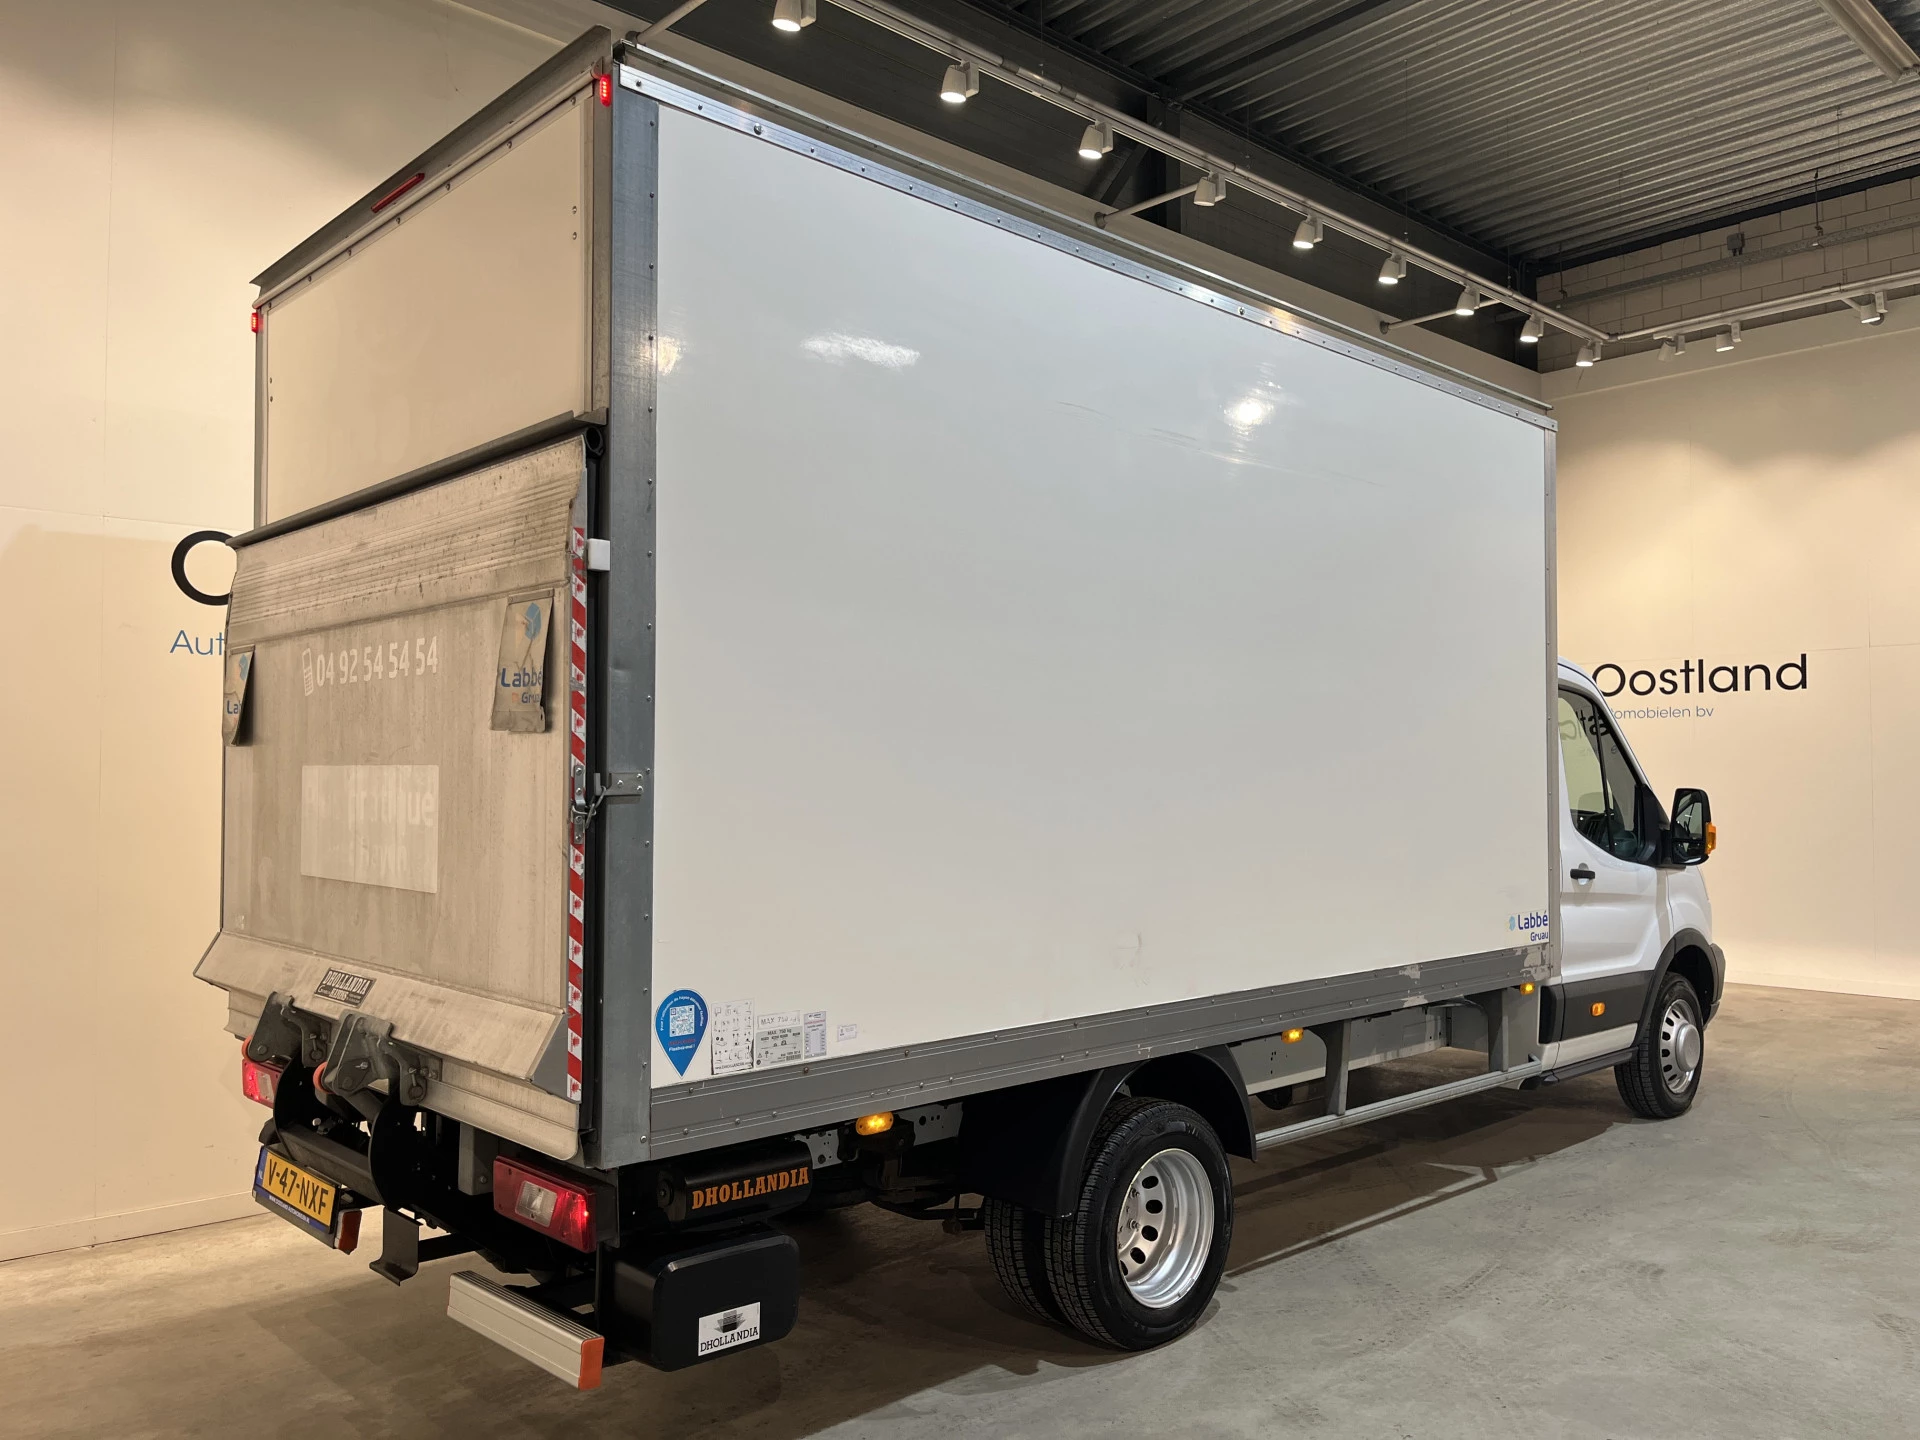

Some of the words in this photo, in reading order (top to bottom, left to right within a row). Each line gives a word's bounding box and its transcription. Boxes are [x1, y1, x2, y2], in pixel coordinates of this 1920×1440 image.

[316, 652, 335, 687] 04
[340, 649, 358, 685] 92
[363, 644, 384, 682] 54
[388, 640, 410, 679] 54
[415, 635, 439, 676] 54
[1592, 653, 1807, 698] Oostland
[1611, 705, 1691, 720] omobielen
[1696, 705, 1714, 718] bv
[1517, 910, 1549, 931] Labbé
[1530, 931, 1549, 942] Gruau
[322, 970, 372, 995] DHOLLANDIA
[268, 1158, 329, 1216] V-47-NXF
[691, 1166, 810, 1210] DHOLLANDIA
[700, 1326, 759, 1352] DHOLLANDIA
